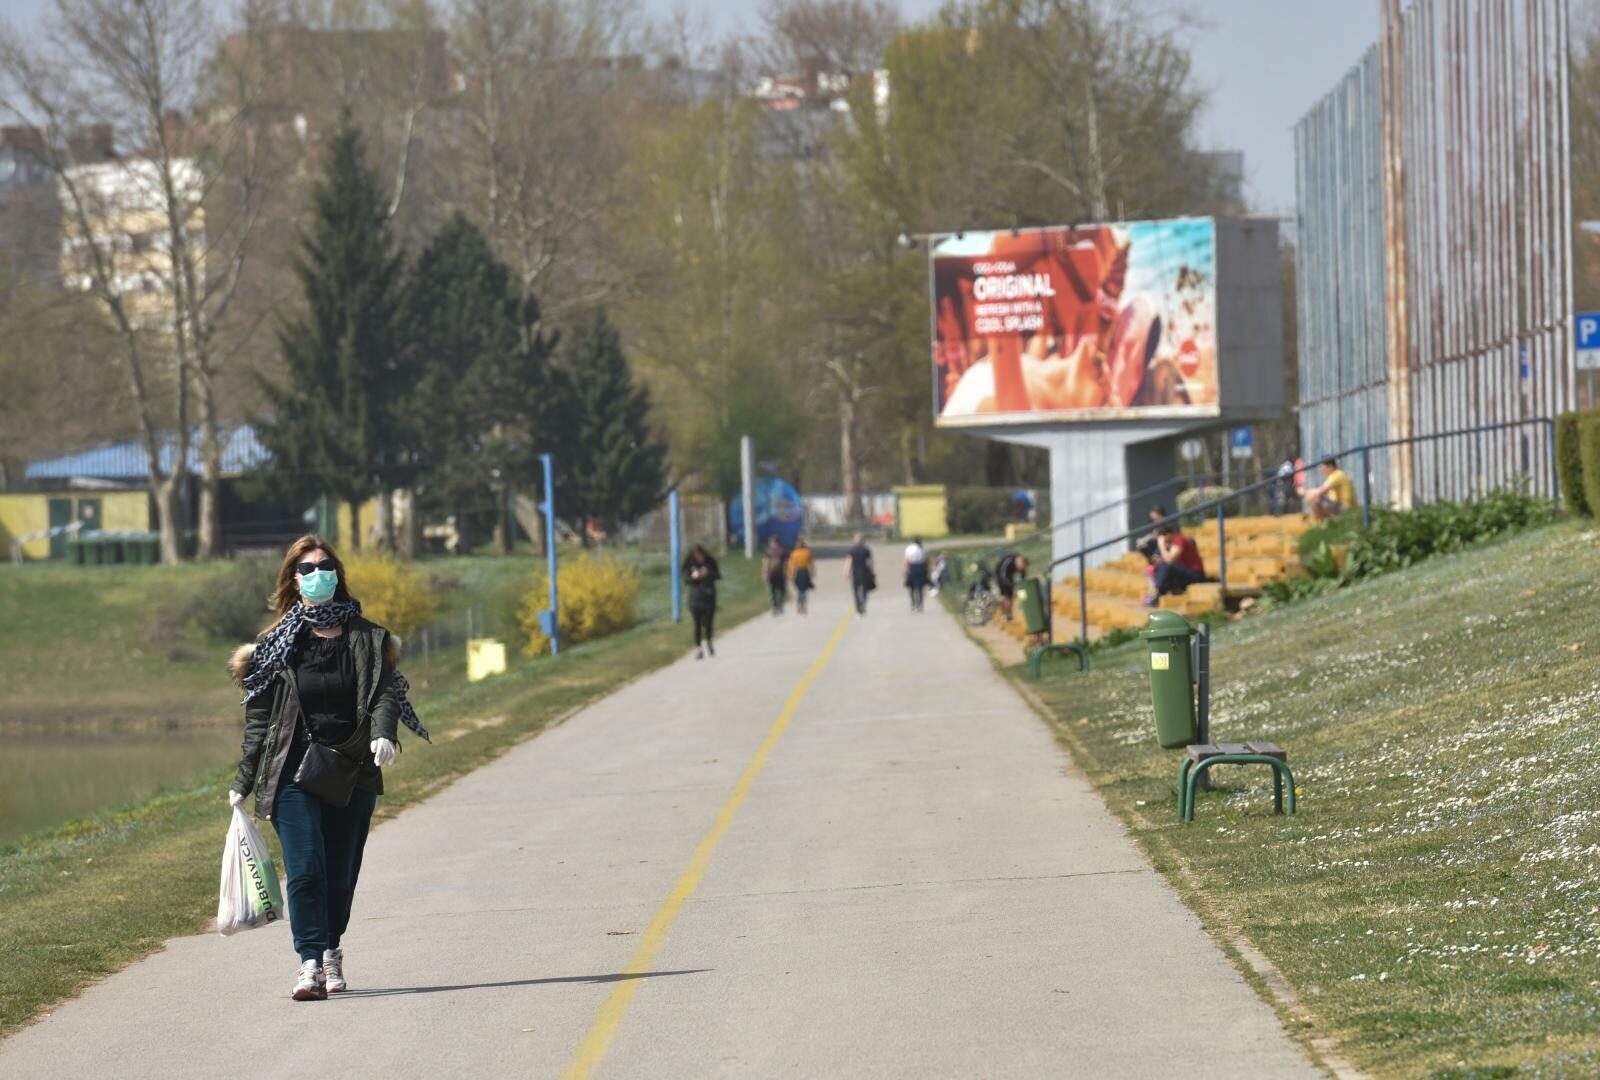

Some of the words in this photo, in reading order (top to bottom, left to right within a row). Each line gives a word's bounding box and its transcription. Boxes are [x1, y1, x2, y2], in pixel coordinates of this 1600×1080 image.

[973, 273, 1056, 301] ORIGINAL
[975, 316, 1003, 334] COOL
[1004, 314, 1044, 332] SPLASH
[1581, 319, 1597, 345] P
[240, 836, 277, 922] DUBRAVICA
